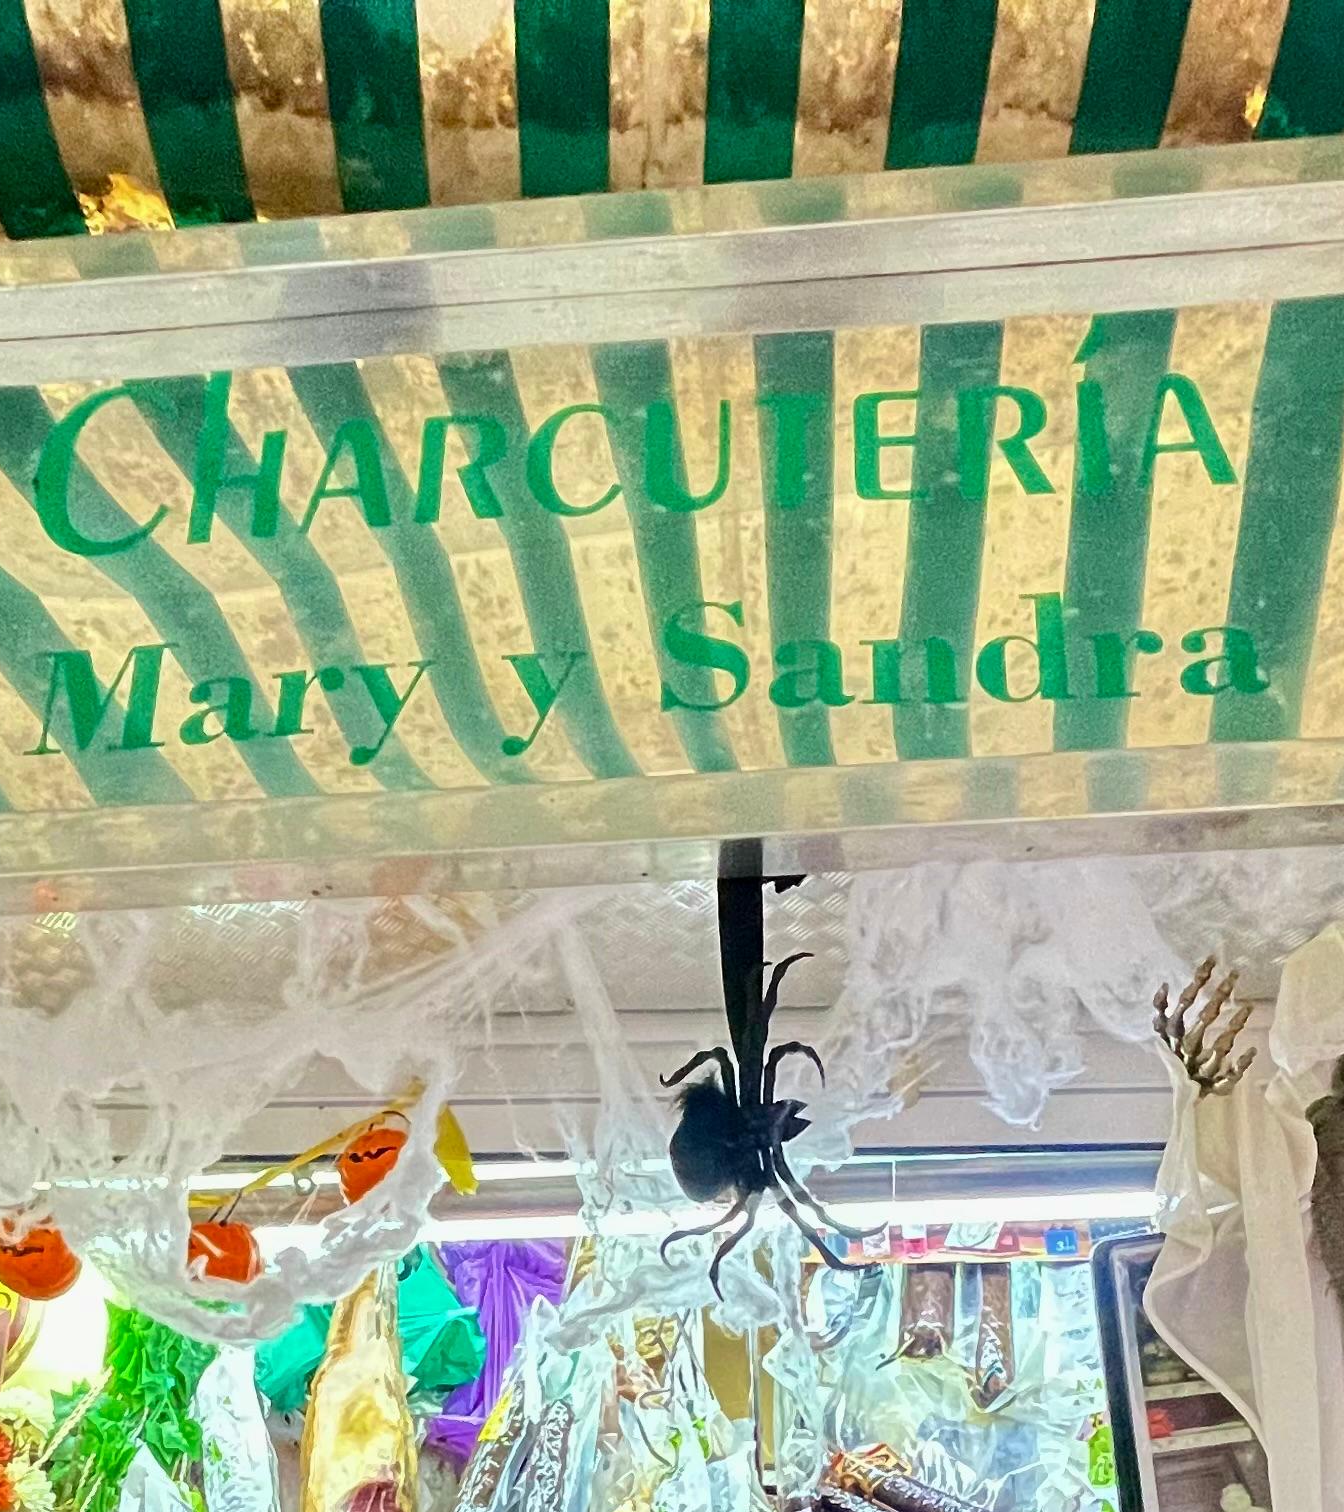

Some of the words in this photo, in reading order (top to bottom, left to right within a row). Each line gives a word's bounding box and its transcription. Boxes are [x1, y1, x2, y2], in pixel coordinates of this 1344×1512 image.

[30, 314, 1238, 558] CHARCUTERÍA
[24, 643, 436, 767] Mary
[501, 648, 588, 757] y
[659, 592, 1269, 712] Sandra
